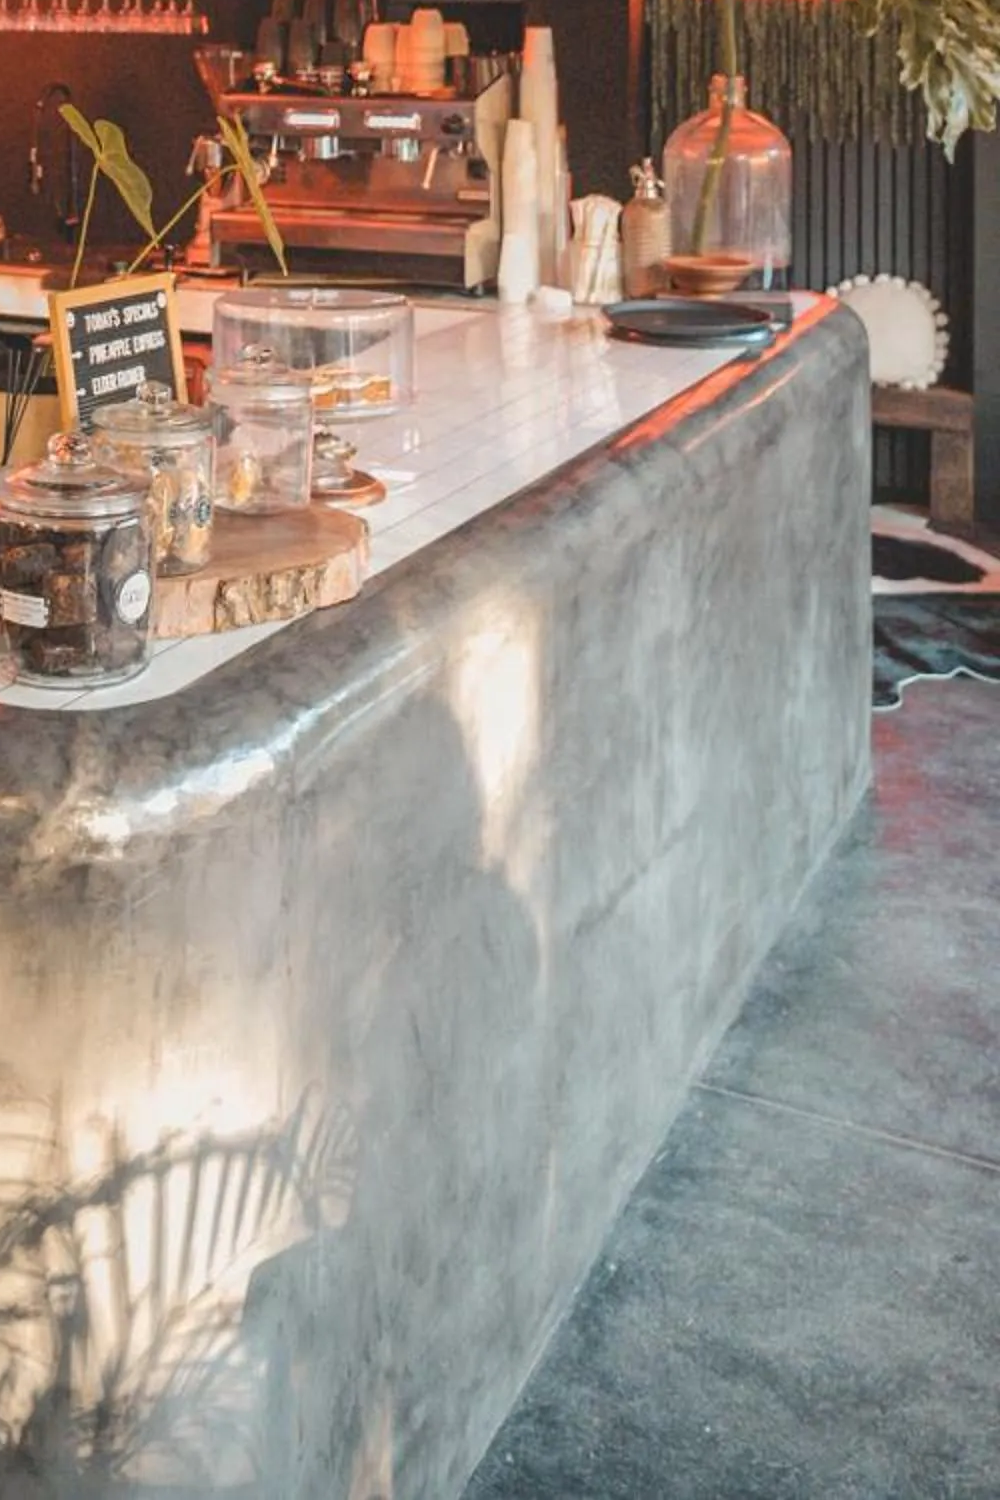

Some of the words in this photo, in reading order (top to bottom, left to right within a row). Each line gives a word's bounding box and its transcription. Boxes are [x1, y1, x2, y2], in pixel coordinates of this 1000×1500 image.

[84, 307, 121, 333] TODAY'S
[122, 301, 160, 326] SPECIALS
[89, 337, 133, 365] PINEAPPLE
